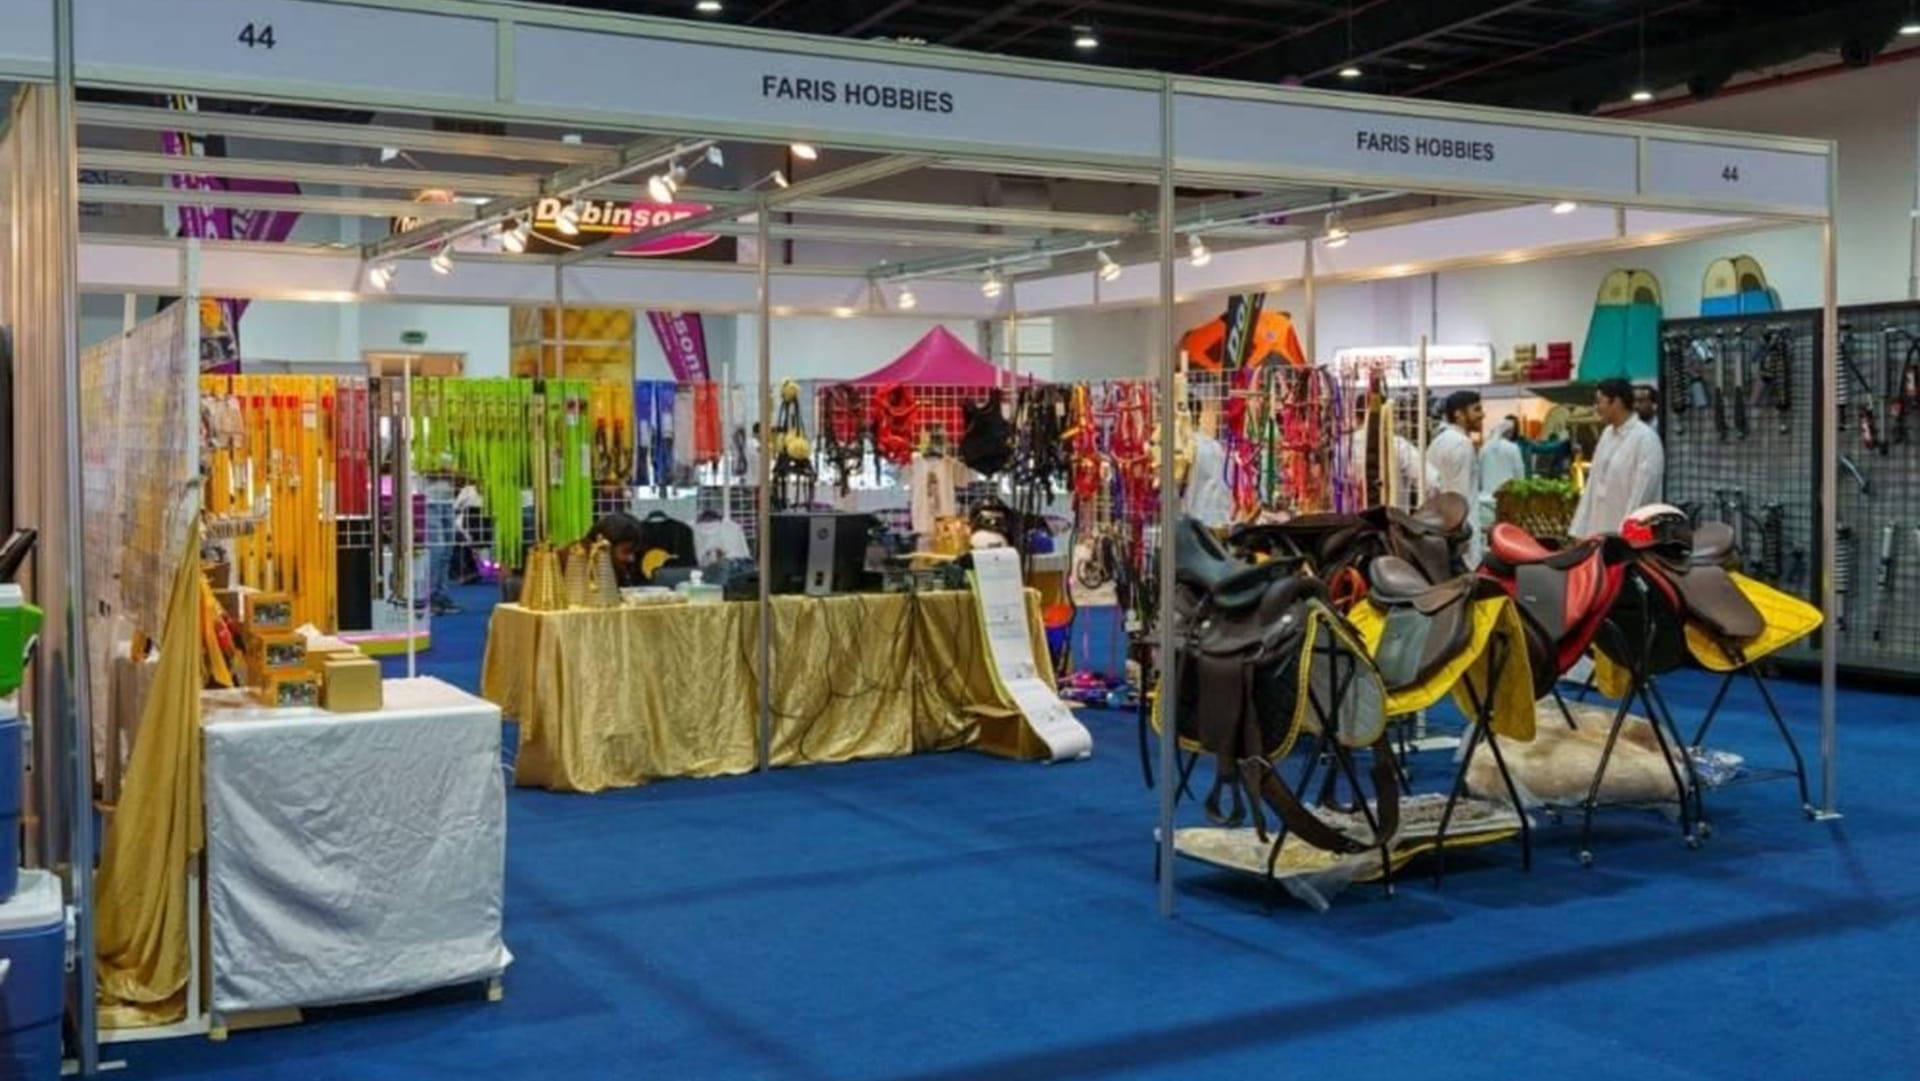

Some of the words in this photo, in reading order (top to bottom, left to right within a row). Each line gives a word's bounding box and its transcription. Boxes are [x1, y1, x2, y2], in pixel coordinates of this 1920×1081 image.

[238, 22, 277, 49] 44
[762, 75, 837, 103] FARIS
[844, 83, 954, 114] HOBBIES
[1356, 131, 1410, 155] FARIS
[1415, 136, 1494, 162] HOBBIES
[1721, 165, 1739, 182] 44
